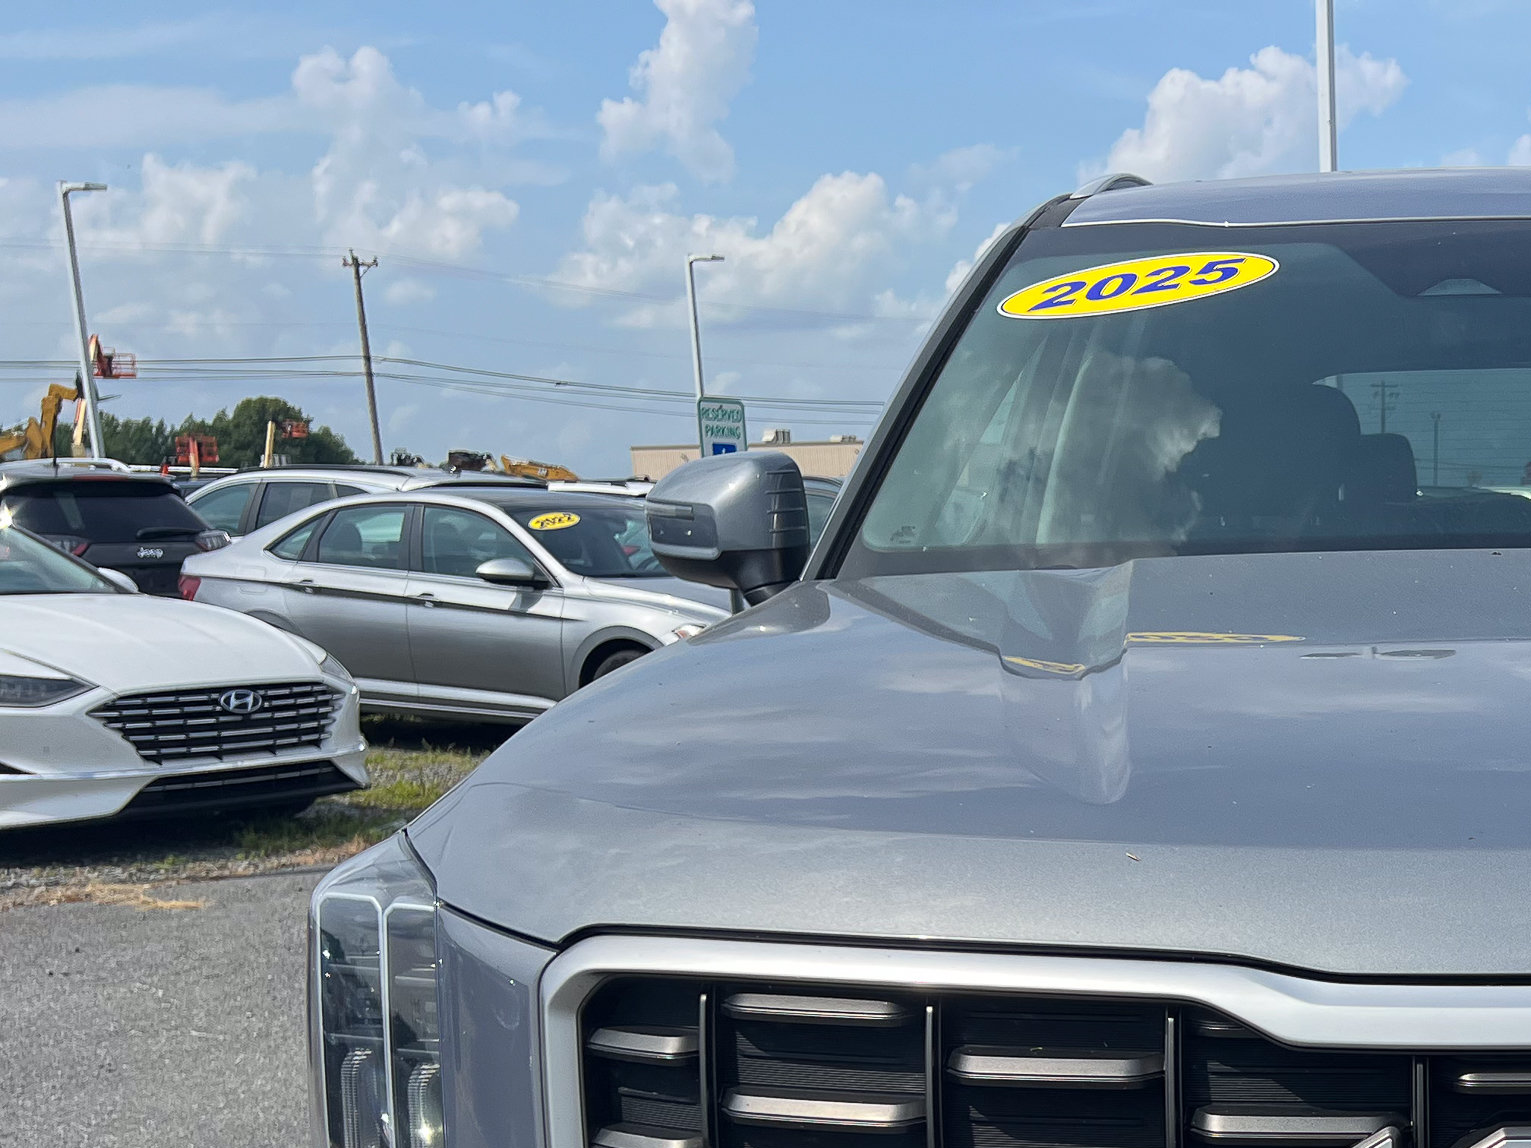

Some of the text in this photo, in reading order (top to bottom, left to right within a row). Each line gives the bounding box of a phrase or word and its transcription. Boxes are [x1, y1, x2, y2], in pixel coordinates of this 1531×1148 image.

[1027, 257, 1248, 313] 2025
[701, 407, 742, 423] RESERVED
[705, 424, 741, 440] PARKING
